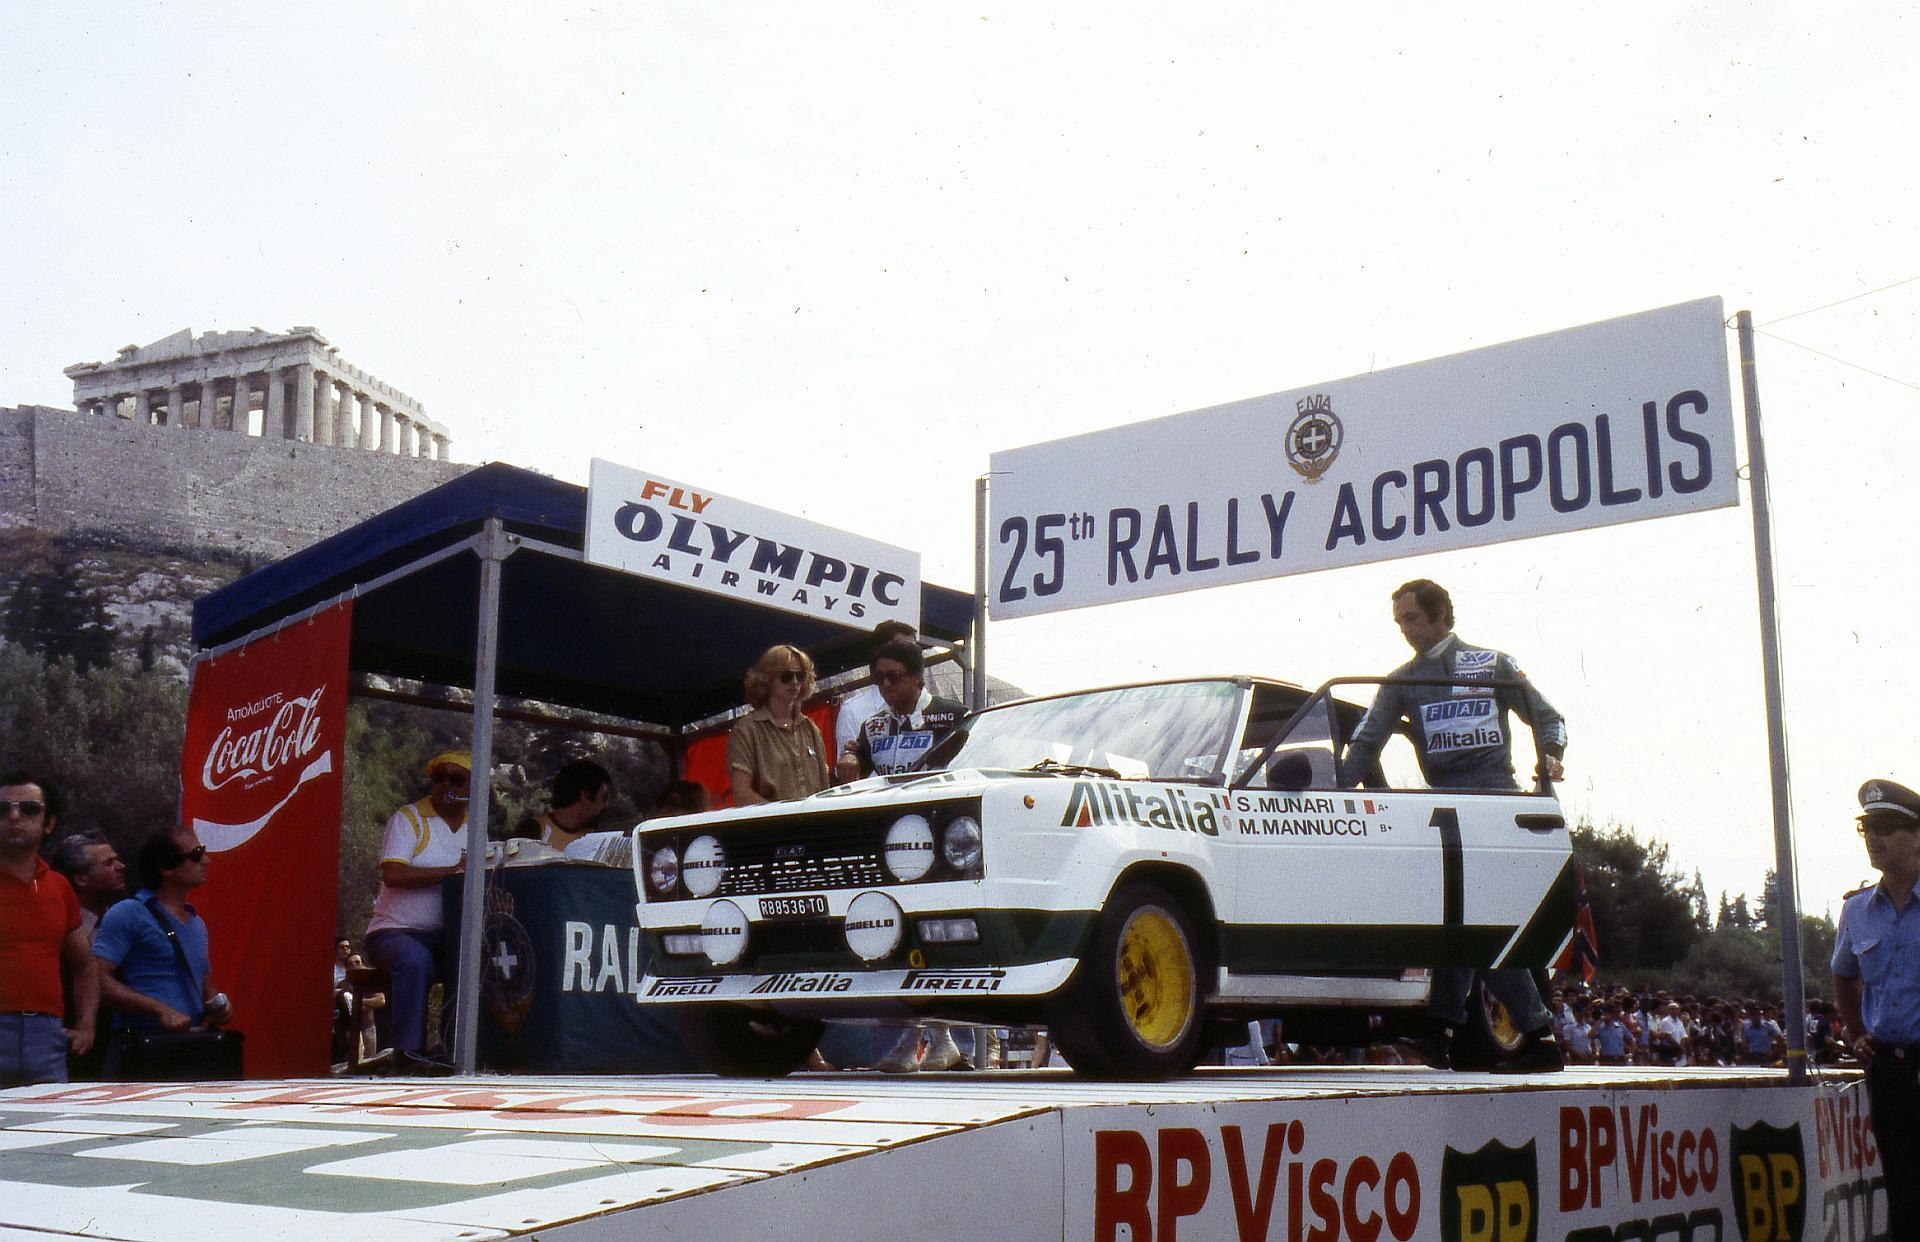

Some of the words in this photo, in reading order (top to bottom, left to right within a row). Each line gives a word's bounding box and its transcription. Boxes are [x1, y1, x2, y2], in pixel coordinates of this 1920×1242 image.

[640, 480, 713, 514] FLY
[1000, 512, 1095, 603] 25th
[1108, 491, 1295, 586] RALLY
[1325, 390, 1712, 551] ACROPOLIS
[614, 500, 905, 606] OLYMPIC
[652, 553, 866, 618] AIRWAYS
[1426, 701, 1491, 721] FIAT
[873, 736, 931, 753] FIAT
[1429, 728, 1501, 750] Alitalia
[1061, 782, 1219, 836] Alitalia
[1429, 808, 1464, 926] 1
[647, 977, 724, 996] PIRELLI
[750, 973, 853, 995] Alitalia
[900, 970, 1006, 991] PIRELLI
[1095, 1127, 1211, 1242] BP
[1221, 1119, 1421, 1242] Visco
[1560, 1106, 1617, 1212] BP
[1620, 1103, 1718, 1203] Visco
[1740, 1153, 1800, 1242] BP
